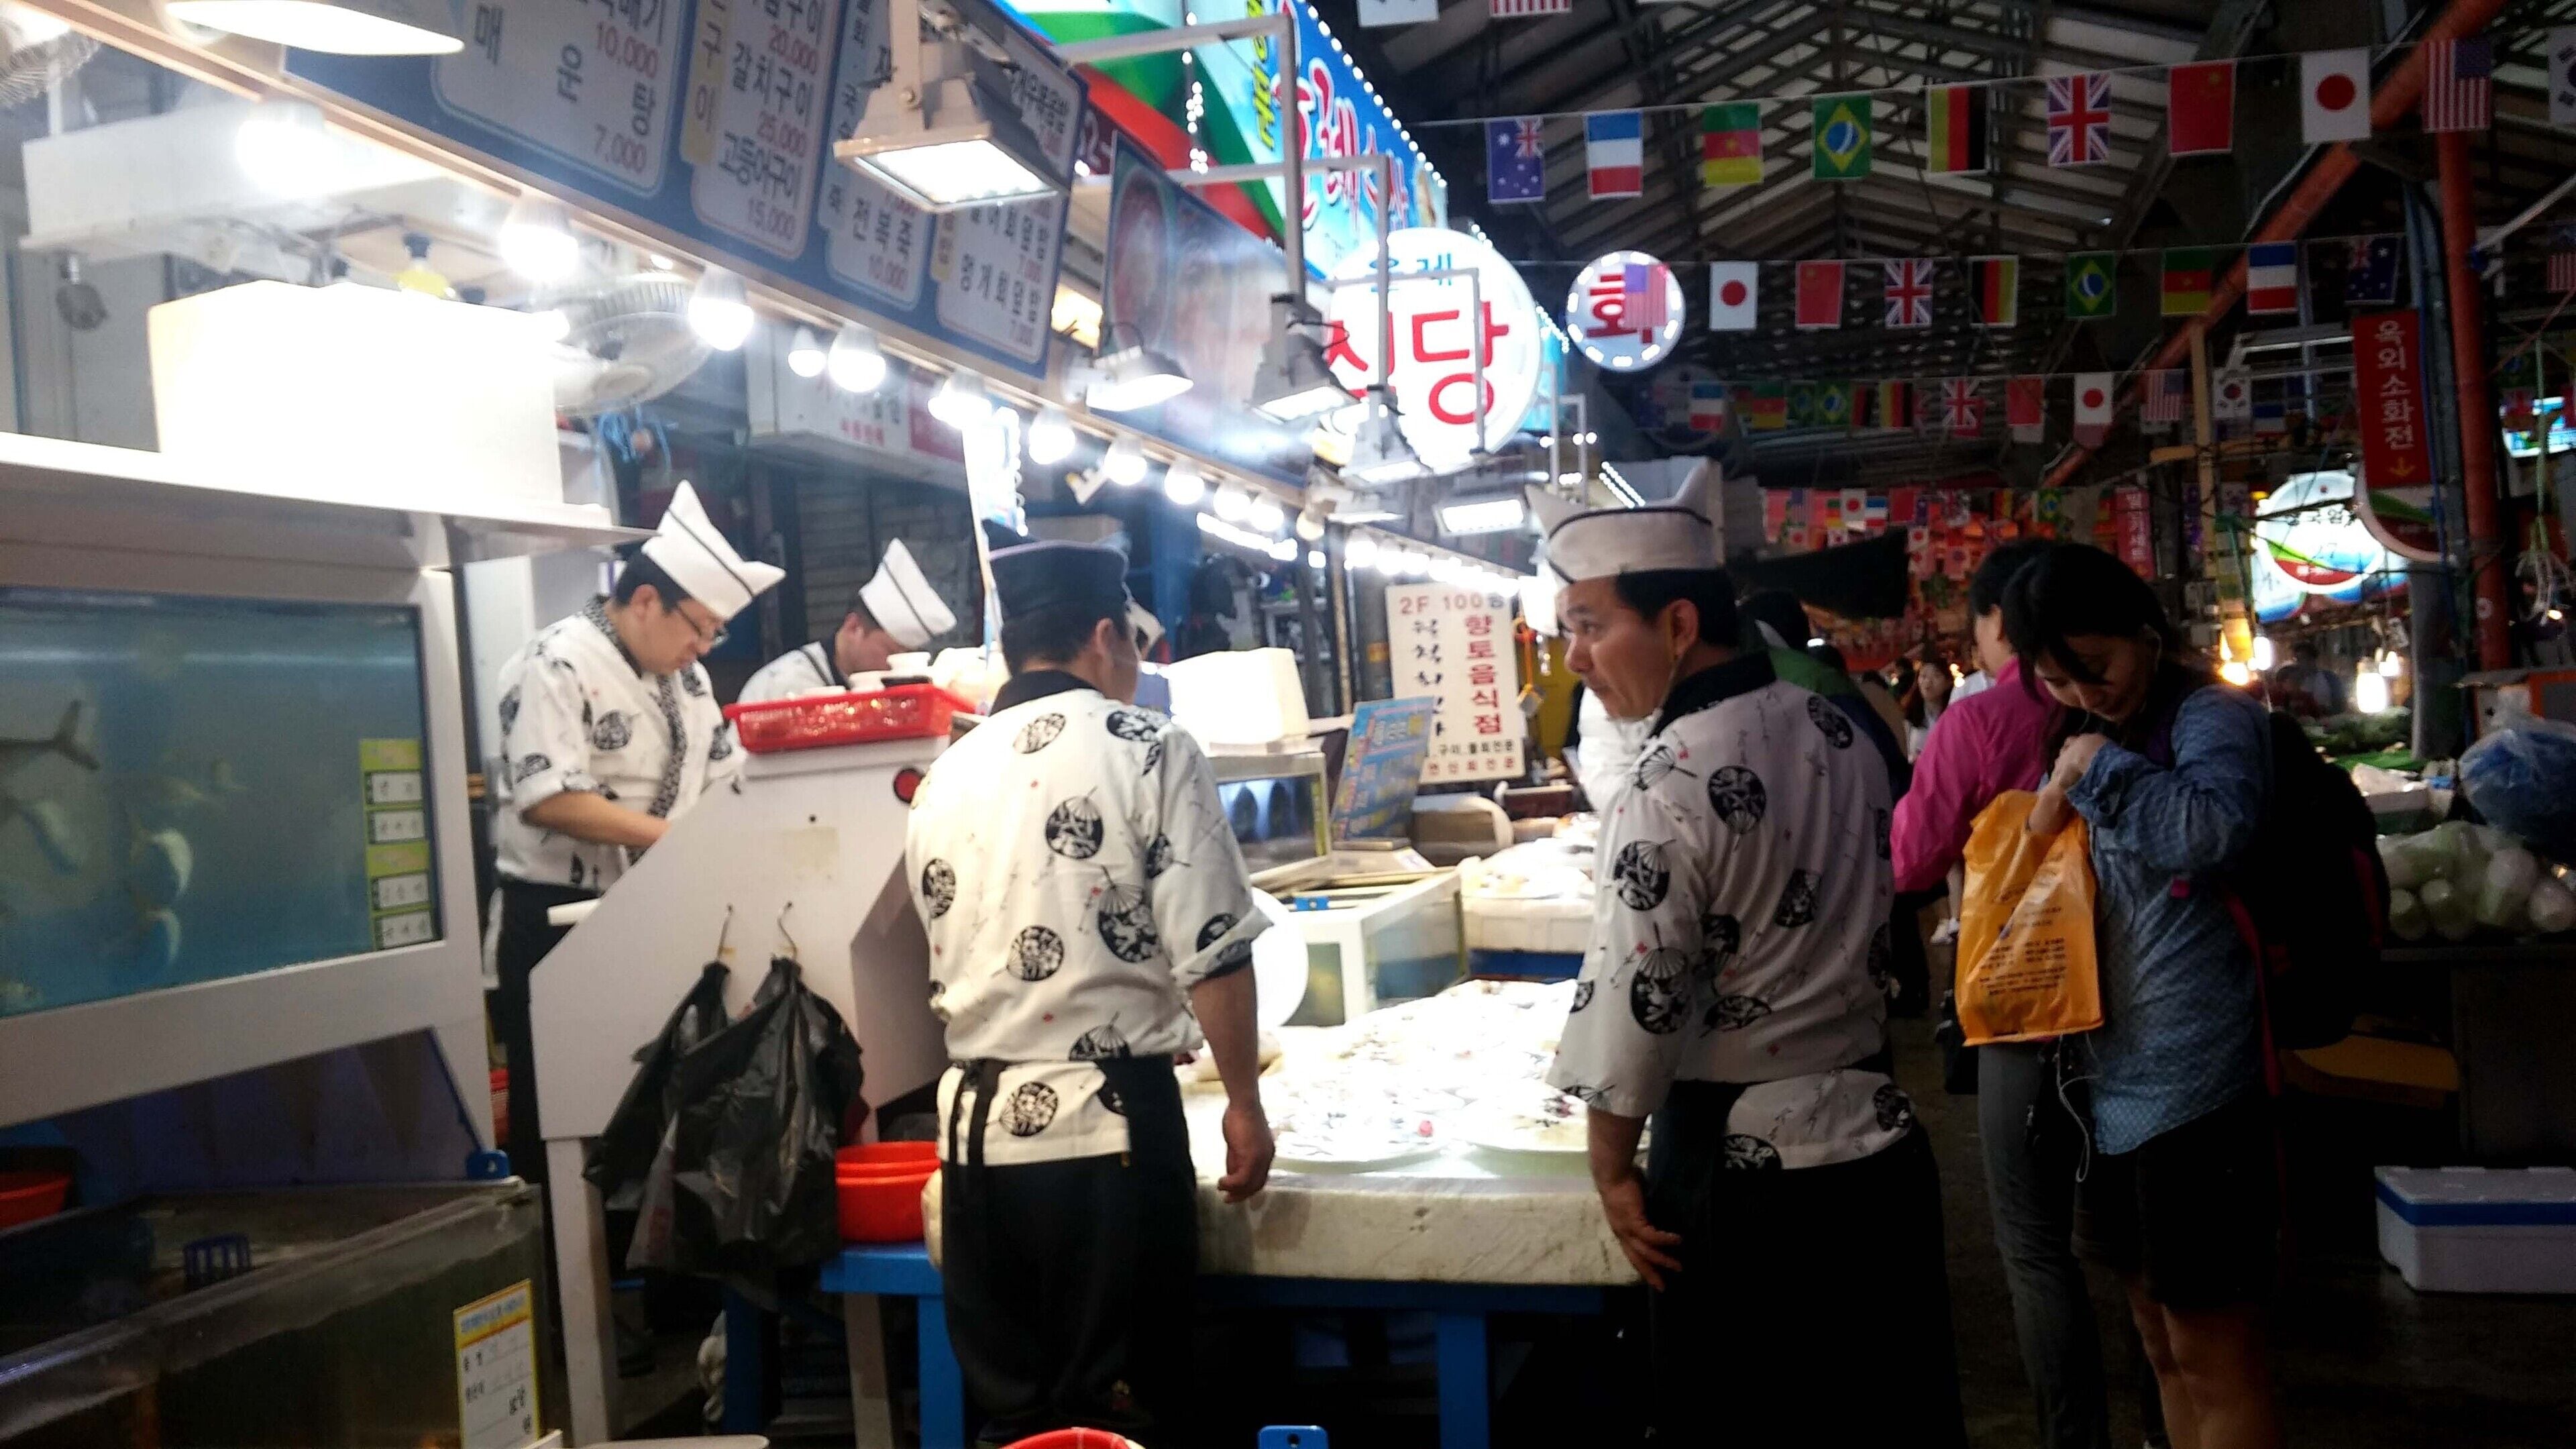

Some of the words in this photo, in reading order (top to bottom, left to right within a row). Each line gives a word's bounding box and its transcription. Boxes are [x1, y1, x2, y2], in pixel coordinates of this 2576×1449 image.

[556, 44, 582, 103] 운
[631, 80, 657, 137] 탕
[2376, 320, 2416, 451] 옥외소화전
[1399, 596, 1430, 615] 2F
[1464, 614, 1502, 735] 향토음식점
